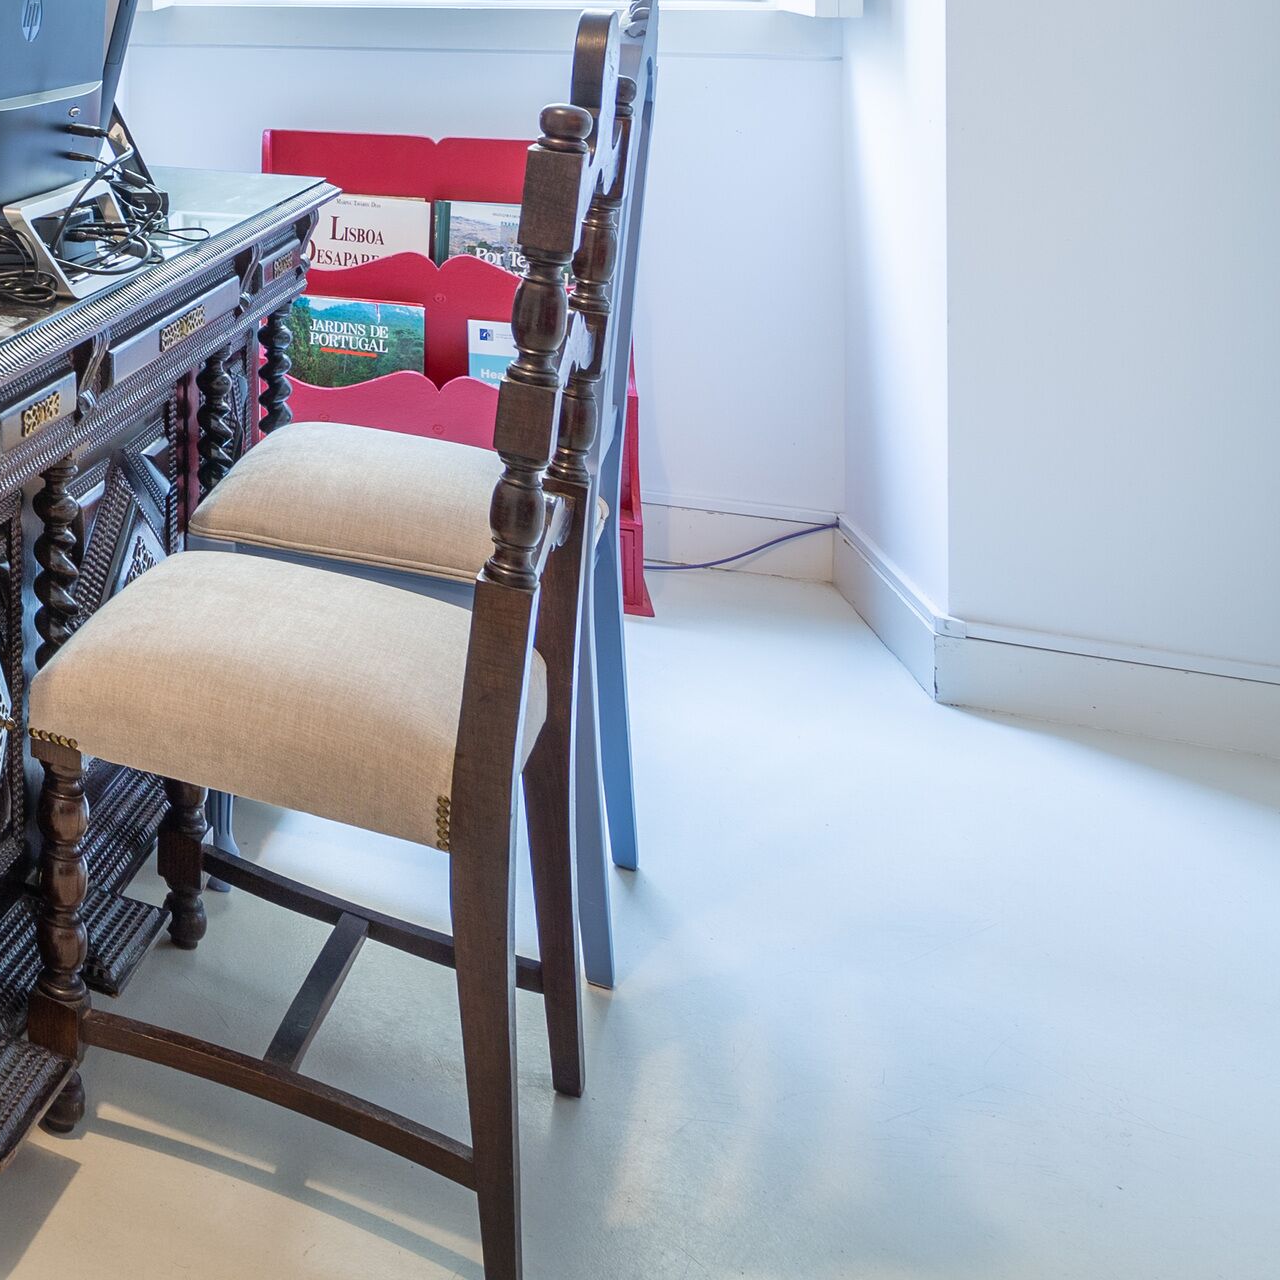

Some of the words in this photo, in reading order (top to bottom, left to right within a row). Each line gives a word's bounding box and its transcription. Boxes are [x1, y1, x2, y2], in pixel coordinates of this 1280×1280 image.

[330, 215, 385, 245] LISBOA
[475, 247, 504, 266] Por
[309, 318, 366, 337] JARDINS
[370, 324, 389, 339] DE
[309, 331, 389, 353] PORTUGAL
